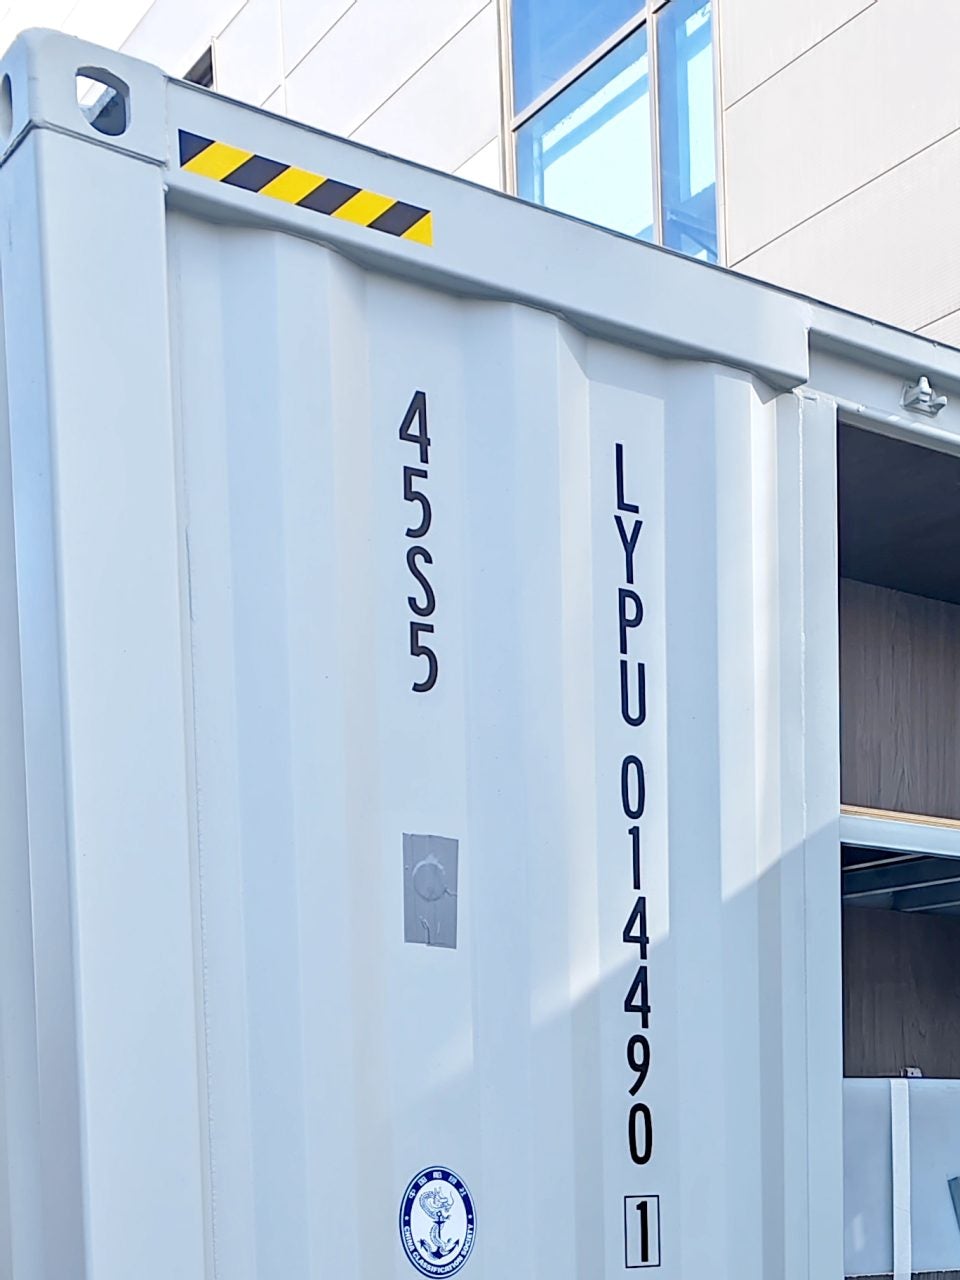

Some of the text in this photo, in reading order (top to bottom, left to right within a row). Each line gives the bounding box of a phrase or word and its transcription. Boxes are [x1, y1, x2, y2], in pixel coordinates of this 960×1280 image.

[398, 390, 438, 693] 45S5
[613, 442, 653, 1263] LYPU 014490 1
[404, 1224, 474, 1274] CHINA CLASSIFICATION SOCIETY
